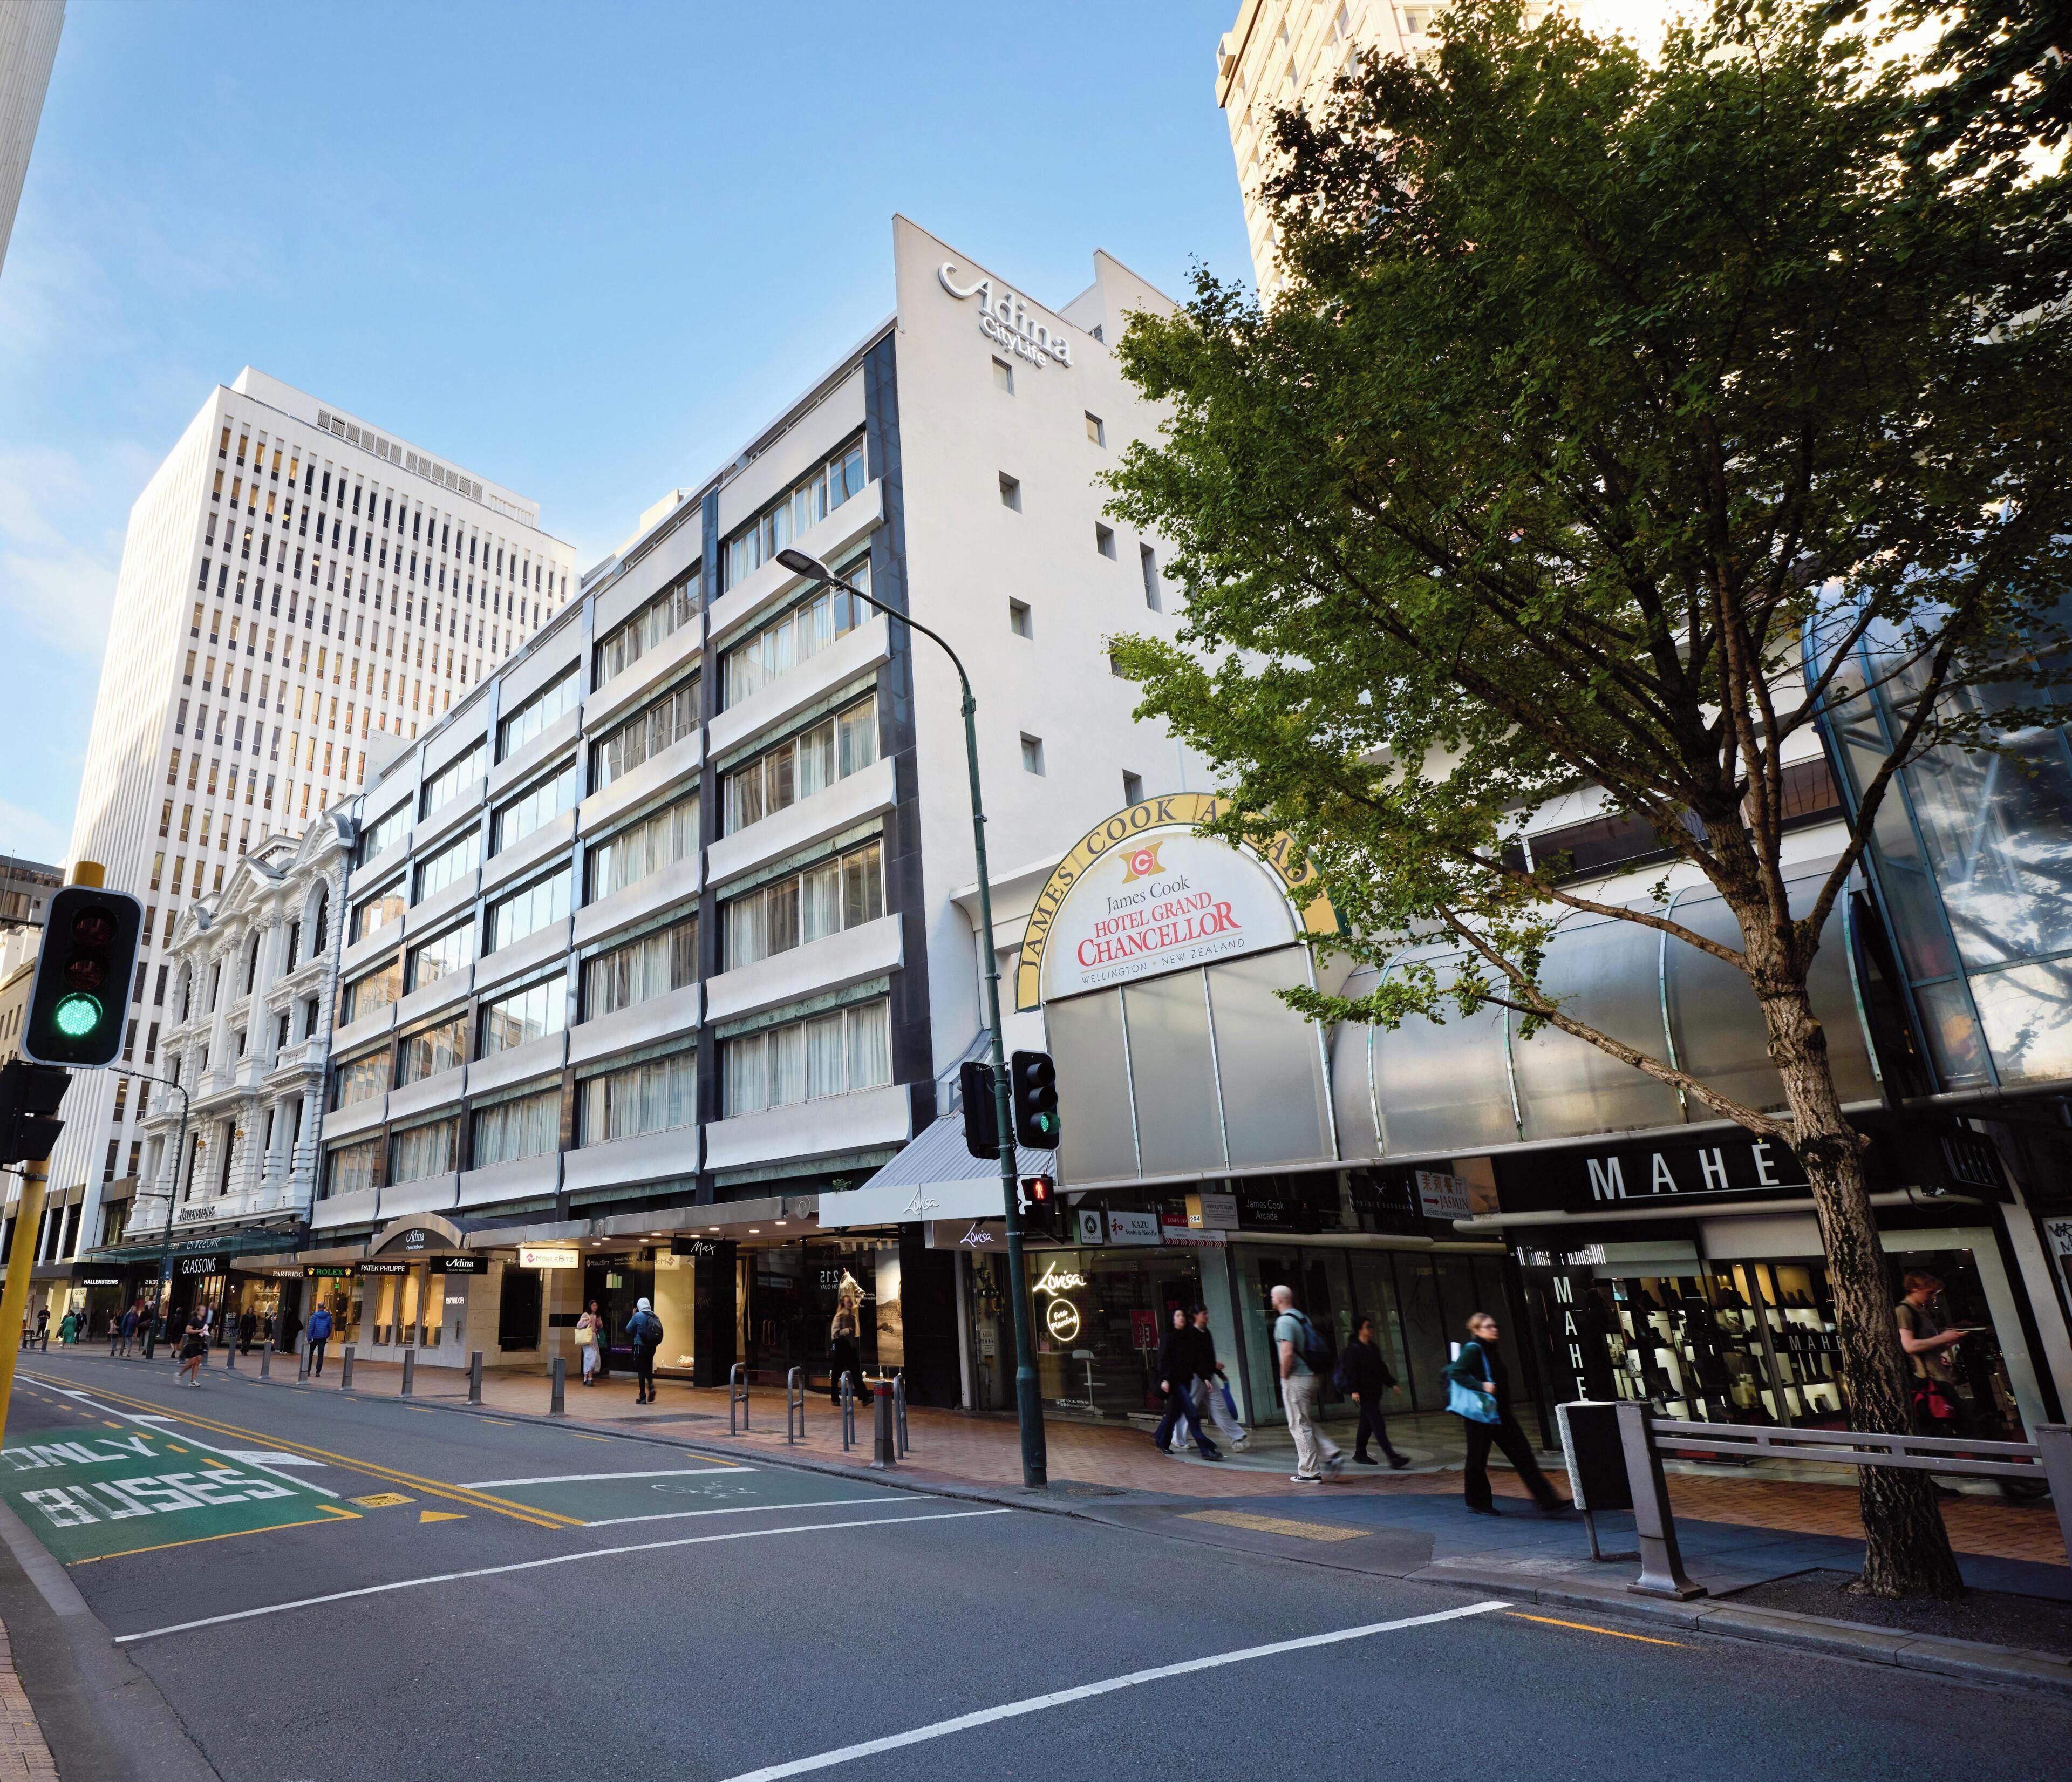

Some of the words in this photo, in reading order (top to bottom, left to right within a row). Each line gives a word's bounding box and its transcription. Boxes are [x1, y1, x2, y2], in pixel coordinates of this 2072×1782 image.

[938, 262, 1074, 368] Adina
[979, 317, 1047, 369] CityLife
[1021, 866, 1073, 970] JAMES
[1087, 798, 1177, 855] COOK
[1106, 892, 1146, 916] James
[1150, 875, 1190, 898] Cook
[1094, 910, 1149, 938] HOTEL
[1151, 892, 1212, 922] GRAND
[1078, 902, 1242, 967] CHANCELLOR
[1082, 962, 1147, 984] WELLINGTON
[1162, 953, 1186, 966] NEW
[1191, 938, 1245, 960] ZEALAND
[179, 1206, 216, 1221] HALLENSTEINS
[903, 1188, 939, 1215] Lovisa
[1246, 1199, 1266, 1209] James
[1267, 1199, 1284, 1209] Cook
[1440, 1195, 1468, 1210] JASMIN
[1256, 1210, 1278, 1220] Arcade
[406, 1230, 425, 1243] Adina
[960, 1222, 996, 1247] Lovisa
[691, 1241, 716, 1256] Max
[182, 1257, 216, 1274] GLASSONS
[446, 1259, 474, 1267] Adina
[1032, 1260, 1087, 1296] Lovisa
[1050, 1315, 1077, 1331] Piercing
[1054, 1310, 1068, 1321] Free
[0, 1436, 159, 1471] ONLY
[20, 1468, 300, 1527] BUSES
